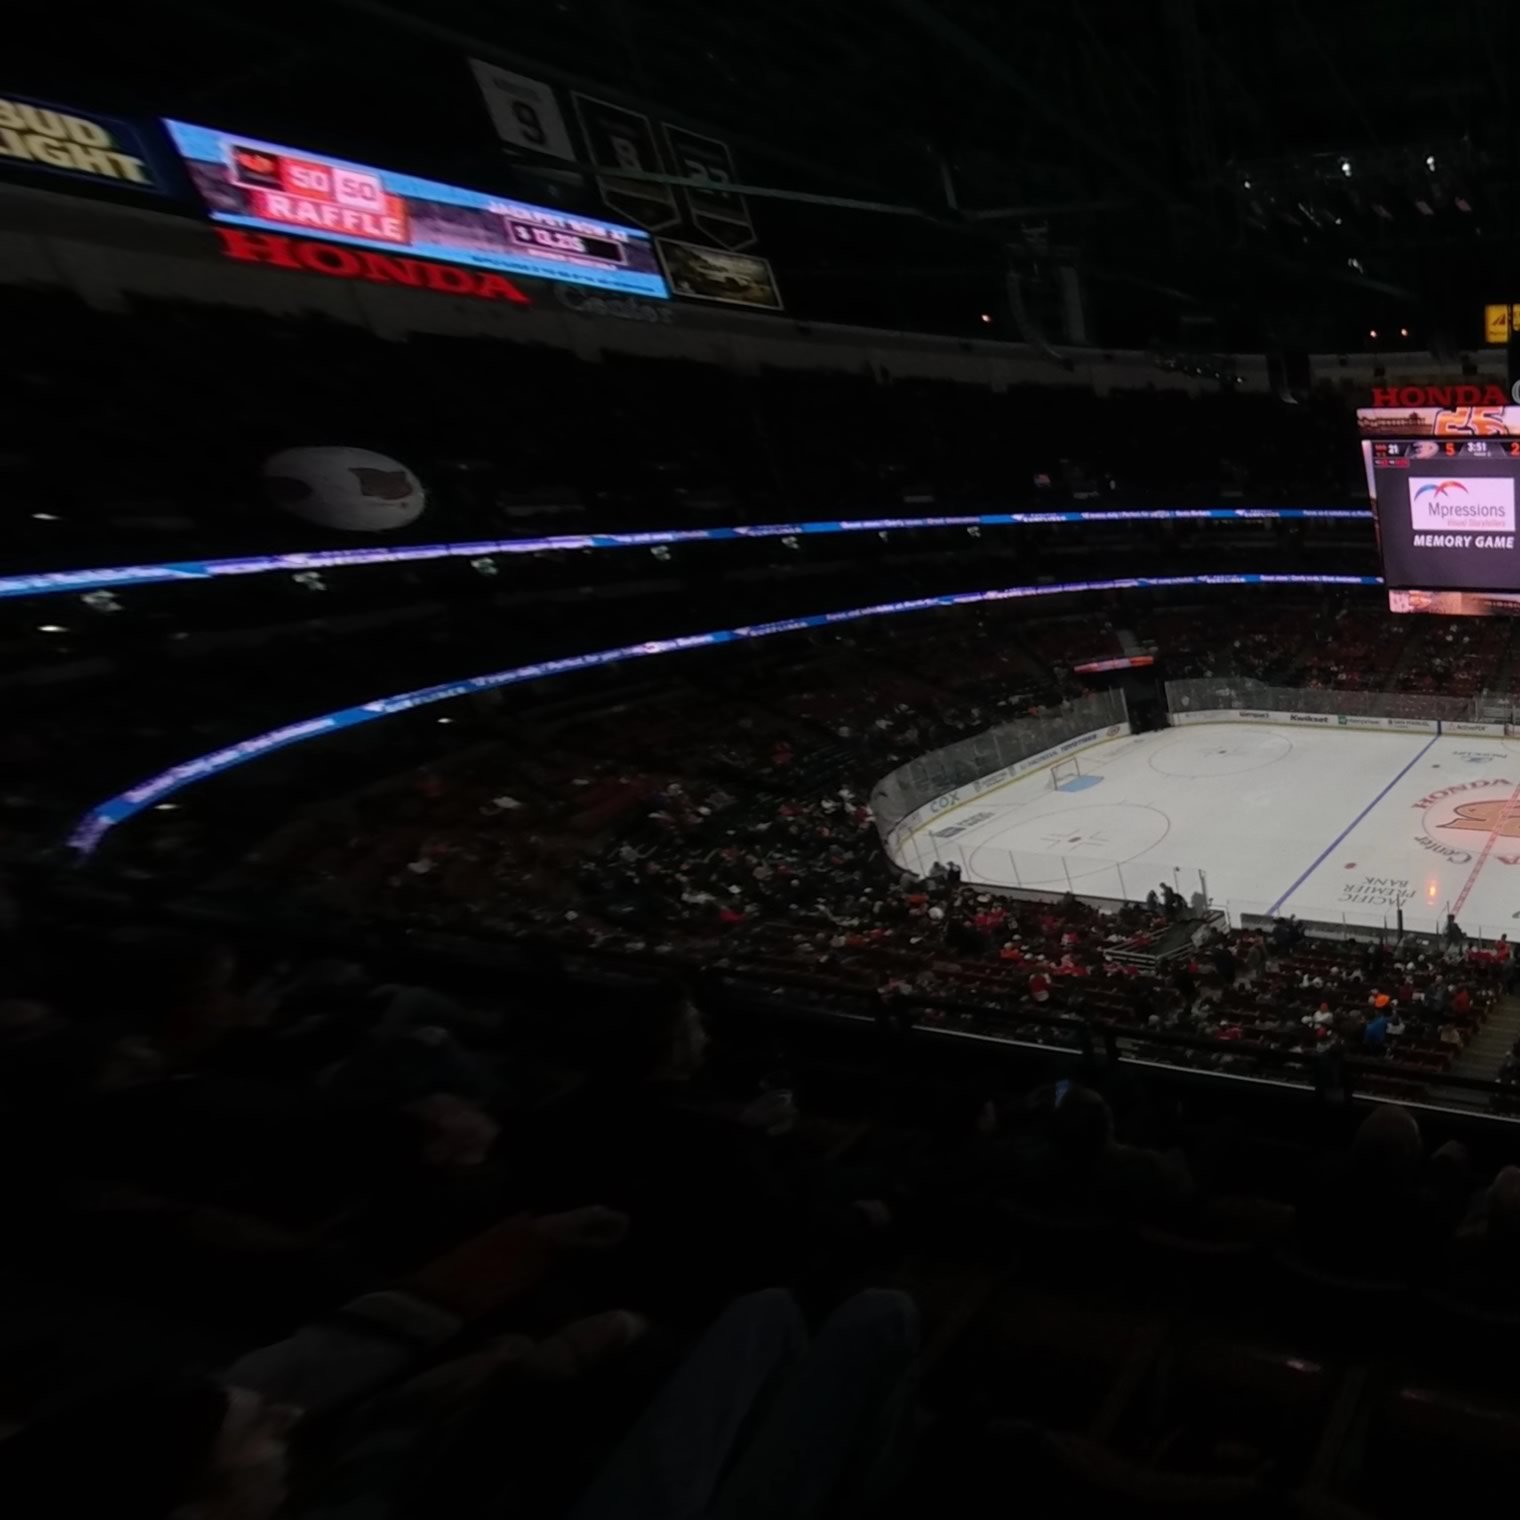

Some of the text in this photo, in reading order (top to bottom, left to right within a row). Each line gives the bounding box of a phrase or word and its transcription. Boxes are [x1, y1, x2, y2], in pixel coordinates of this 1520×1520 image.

[0, 99, 112, 149] BUD
[512, 100, 547, 146] 9
[265, 193, 404, 239] RAFFLE
[215, 227, 532, 306] HONDA
[1370, 385, 1509, 409] HONDA
[1445, 441, 1455, 457] 5
[1467, 441, 1487, 452] 3:51
[1511, 442, 1520, 456] 2
[1428, 501, 1506, 518] Mpressions
[1413, 534, 1515, 549] MEMORY GAME
[1290, 713, 1329, 724] Kwikset
[930, 789, 961, 814] COX
[1411, 777, 1513, 811] HONDA
[1414, 834, 1473, 865] Center
[1342, 883, 1417, 899] PREMIER
[1364, 876, 1410, 888] BANK
[1338, 894, 1407, 908] PACIFIC
